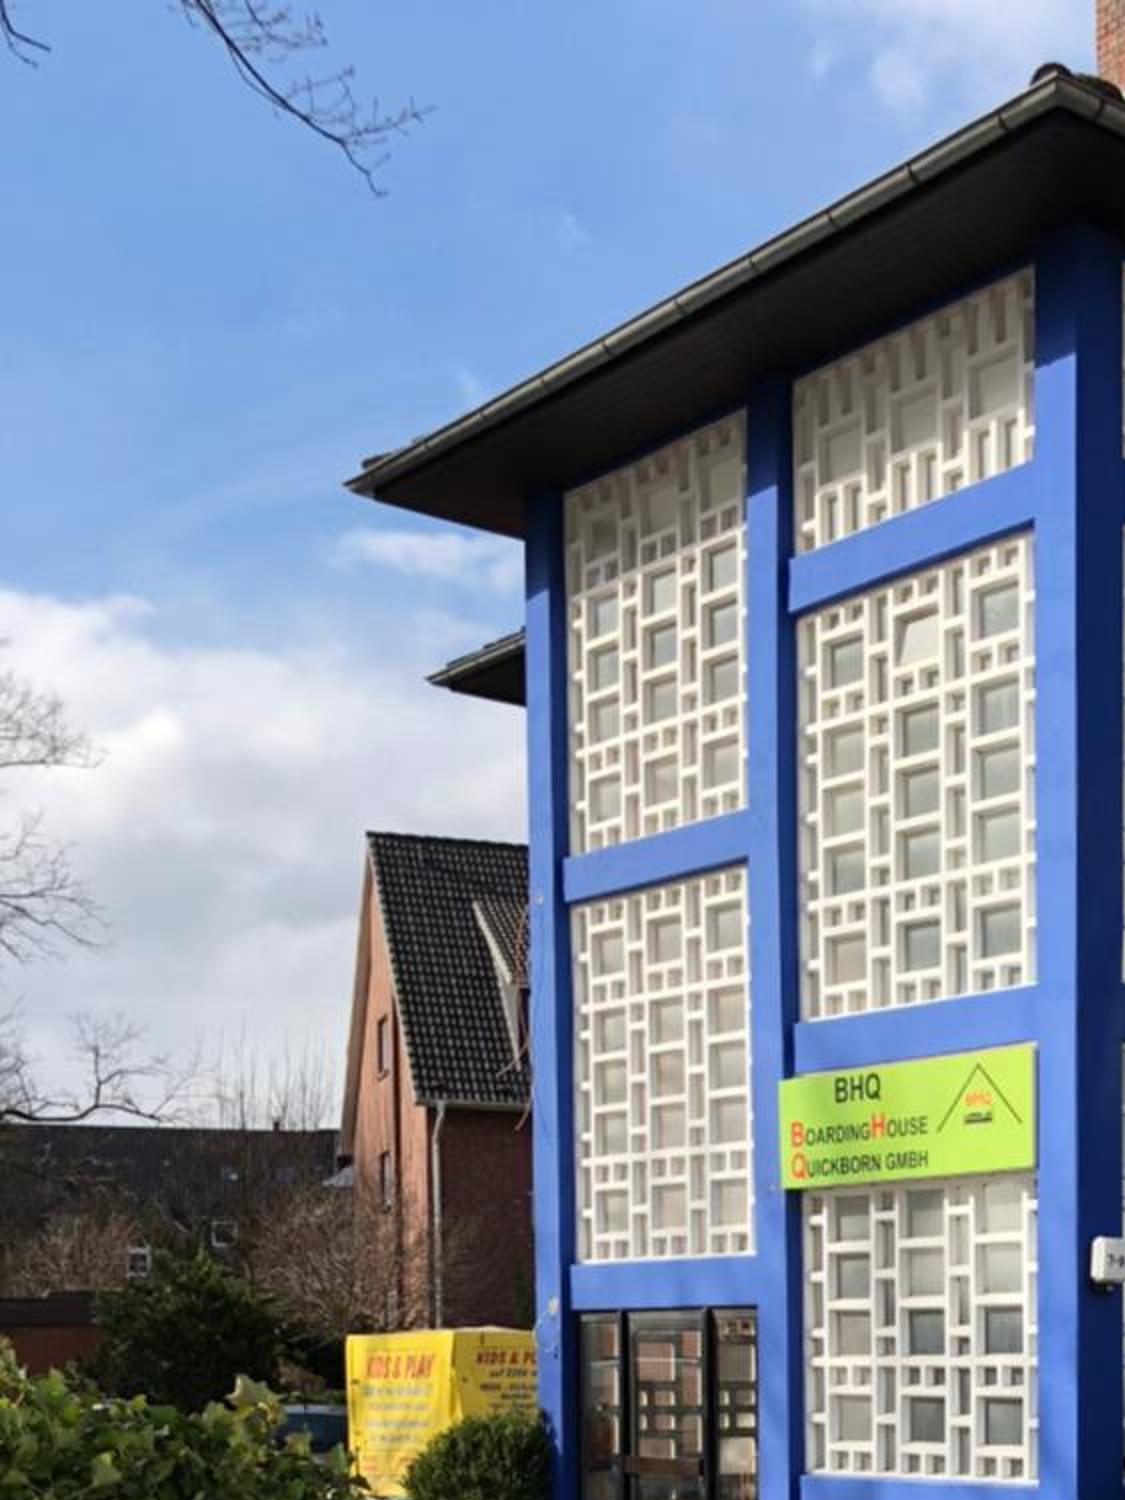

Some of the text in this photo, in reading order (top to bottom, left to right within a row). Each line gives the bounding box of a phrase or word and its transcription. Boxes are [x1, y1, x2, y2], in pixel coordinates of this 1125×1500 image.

[834, 1073, 881, 1103] BHQ
[790, 1112, 929, 1148] BOARDINGHOUSE
[790, 1150, 929, 1180] QUICKBORN GMBH
[405, 1353, 436, 1378] PLAY
[477, 1351, 507, 1364] KIDS
